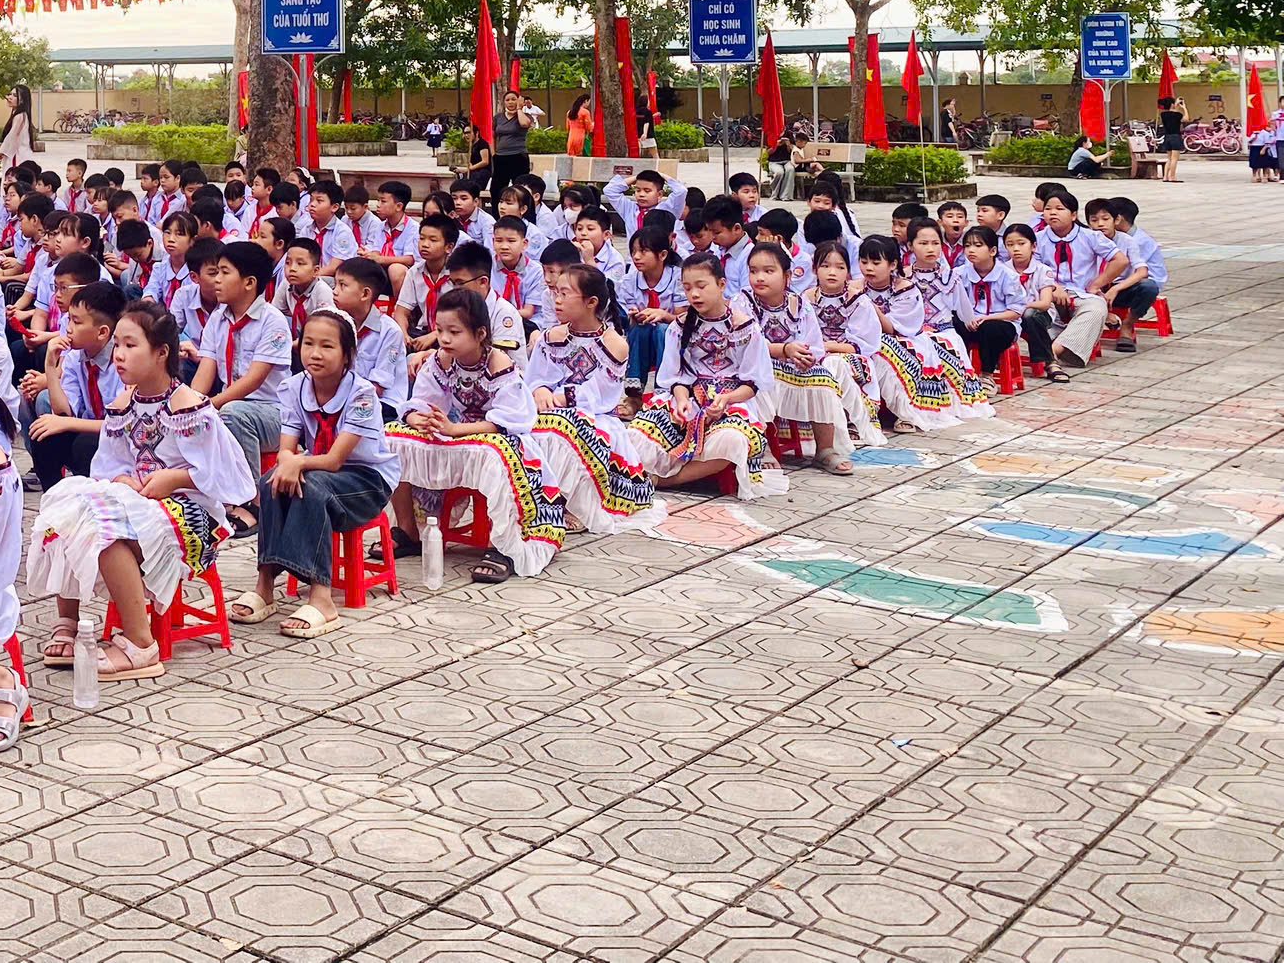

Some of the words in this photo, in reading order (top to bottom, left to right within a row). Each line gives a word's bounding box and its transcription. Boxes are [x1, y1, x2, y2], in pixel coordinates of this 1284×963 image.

[708, 1, 722, 14] CHỈ
[723, 2, 735, 14] CÓ
[273, 10, 290, 28] CỦA
[292, 8, 311, 27] TUỔI
[312, 11, 329, 26] THƠ
[703, 20, 719, 32] HỌC
[721, 19, 741, 29] SINH
[699, 34, 720, 45] CHƯA
[722, 33, 746, 45] CHĂM
